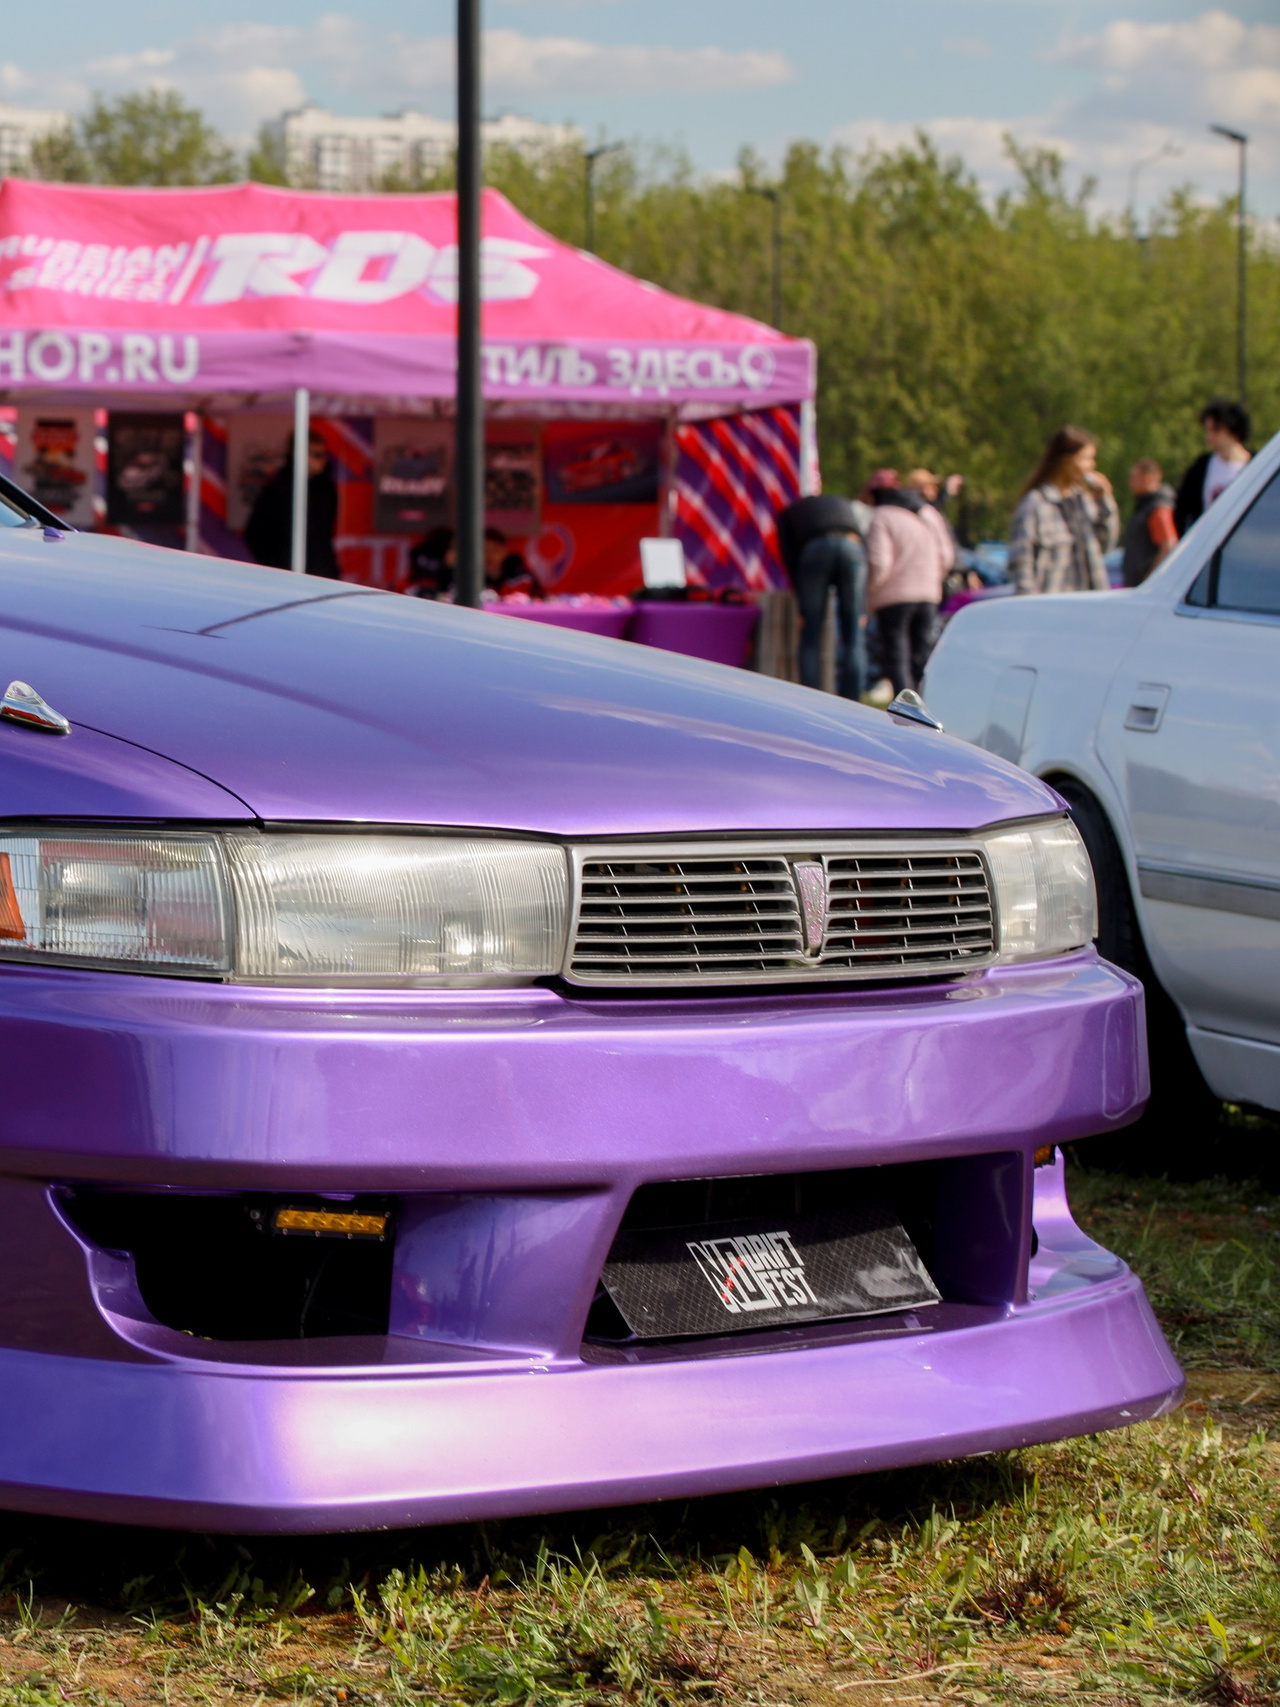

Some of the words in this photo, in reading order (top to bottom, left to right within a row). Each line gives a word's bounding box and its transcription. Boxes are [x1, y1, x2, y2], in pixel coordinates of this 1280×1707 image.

[200, 230, 555, 304] RDS
[480, 345, 596, 388] ТИЛЬ
[733, 1230, 805, 1271] DRIFT
[756, 1266, 818, 1307] FEST
